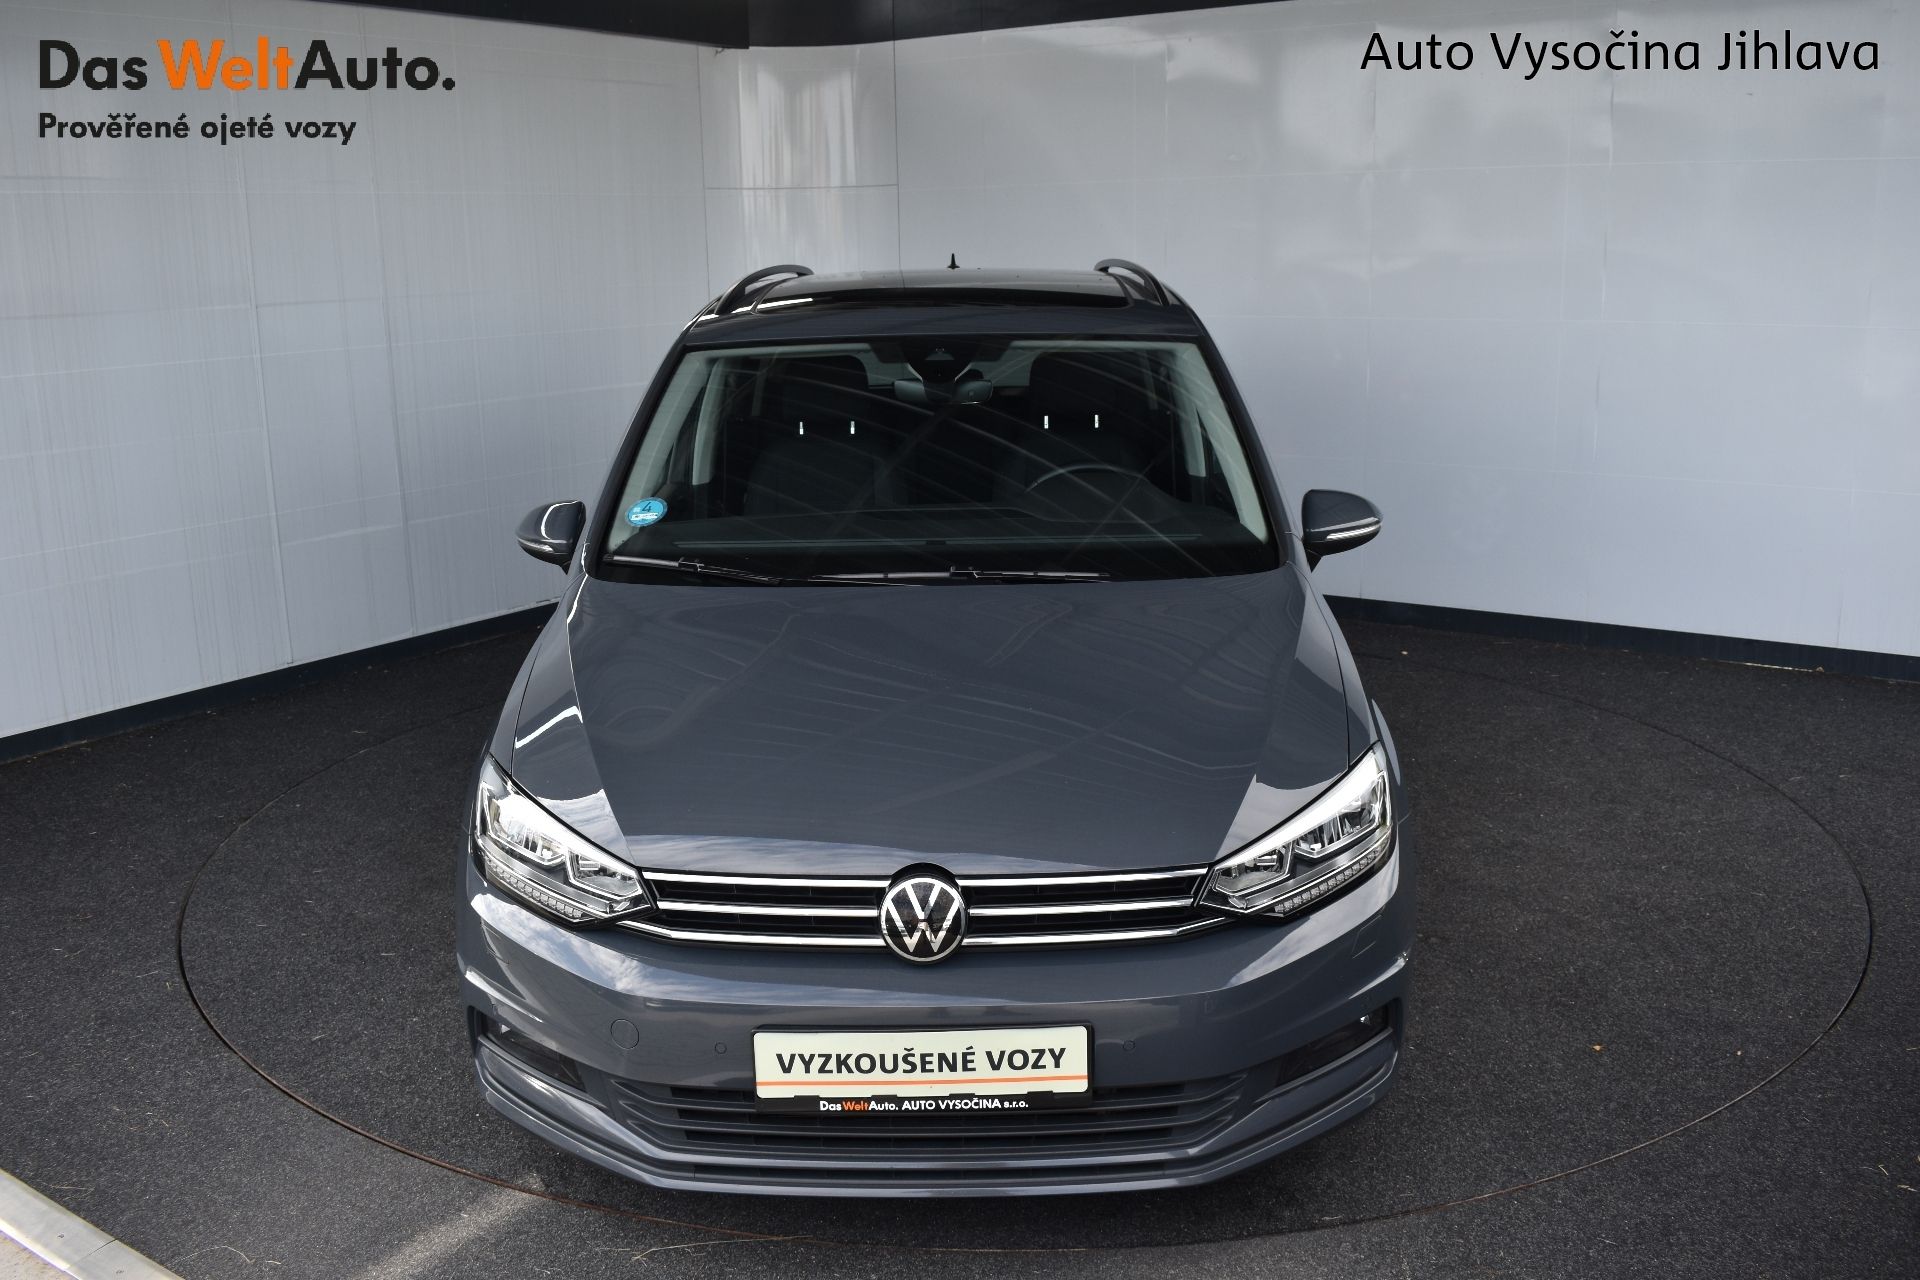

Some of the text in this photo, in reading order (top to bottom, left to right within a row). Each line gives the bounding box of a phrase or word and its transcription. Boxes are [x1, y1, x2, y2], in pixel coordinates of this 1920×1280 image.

[776, 1046, 1067, 1074] VYZKOUŠENÉ VOZY
[819, 1100, 842, 1111] Das
[901, 1100, 936, 1111] AUTO
[938, 1098, 1002, 1110] VYSOČINA
